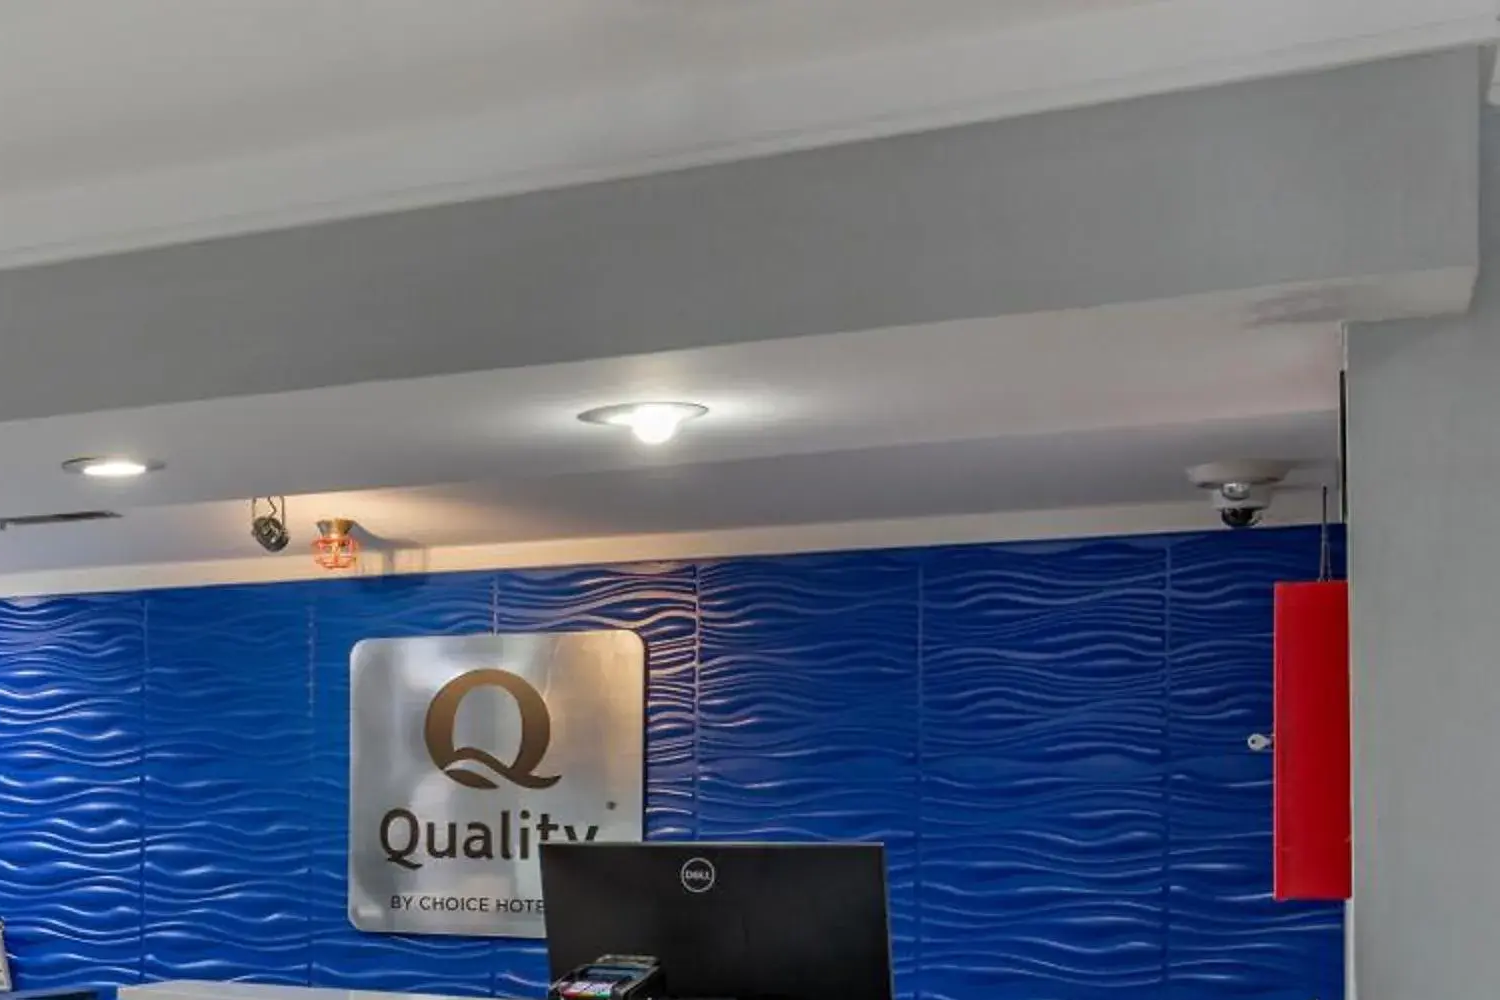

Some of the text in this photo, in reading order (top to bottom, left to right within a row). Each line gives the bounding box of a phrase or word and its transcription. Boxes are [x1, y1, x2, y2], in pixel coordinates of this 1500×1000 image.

[425, 669, 562, 789] Q
[390, 896, 546, 914] BY CHOICE HOTE
